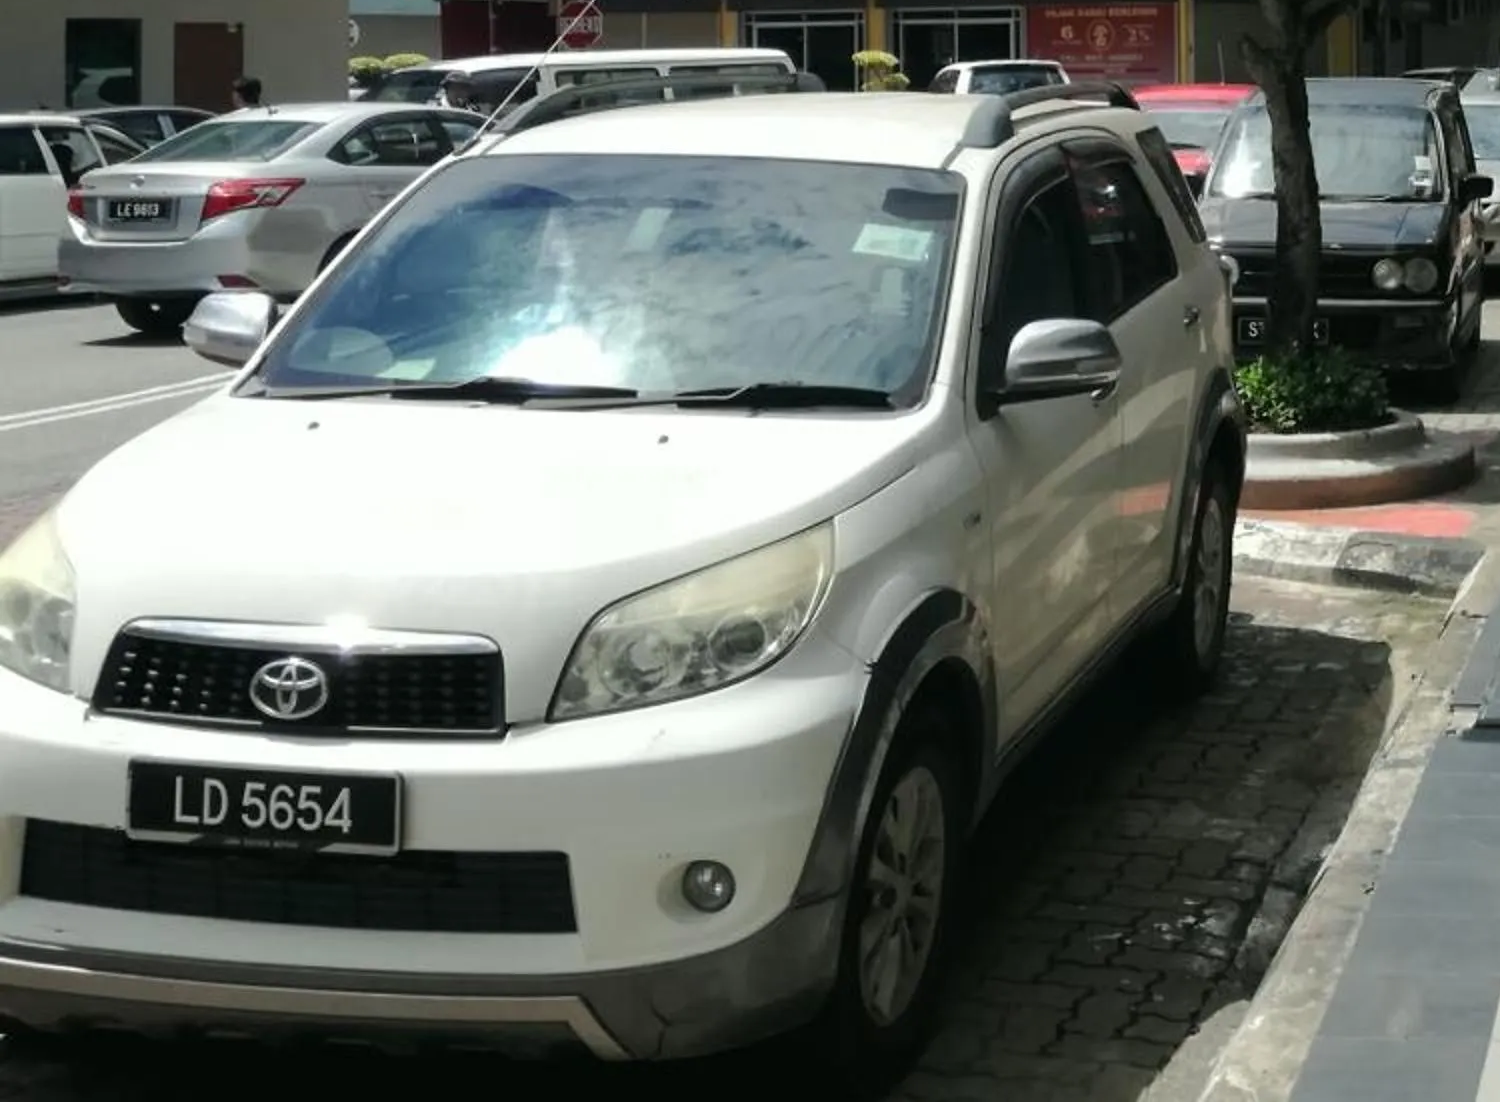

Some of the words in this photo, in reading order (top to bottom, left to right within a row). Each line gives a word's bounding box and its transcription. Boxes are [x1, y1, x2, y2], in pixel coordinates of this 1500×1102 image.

[117, 203, 132, 217] LE
[174, 774, 229, 826] LD
[241, 781, 353, 834] 5654
